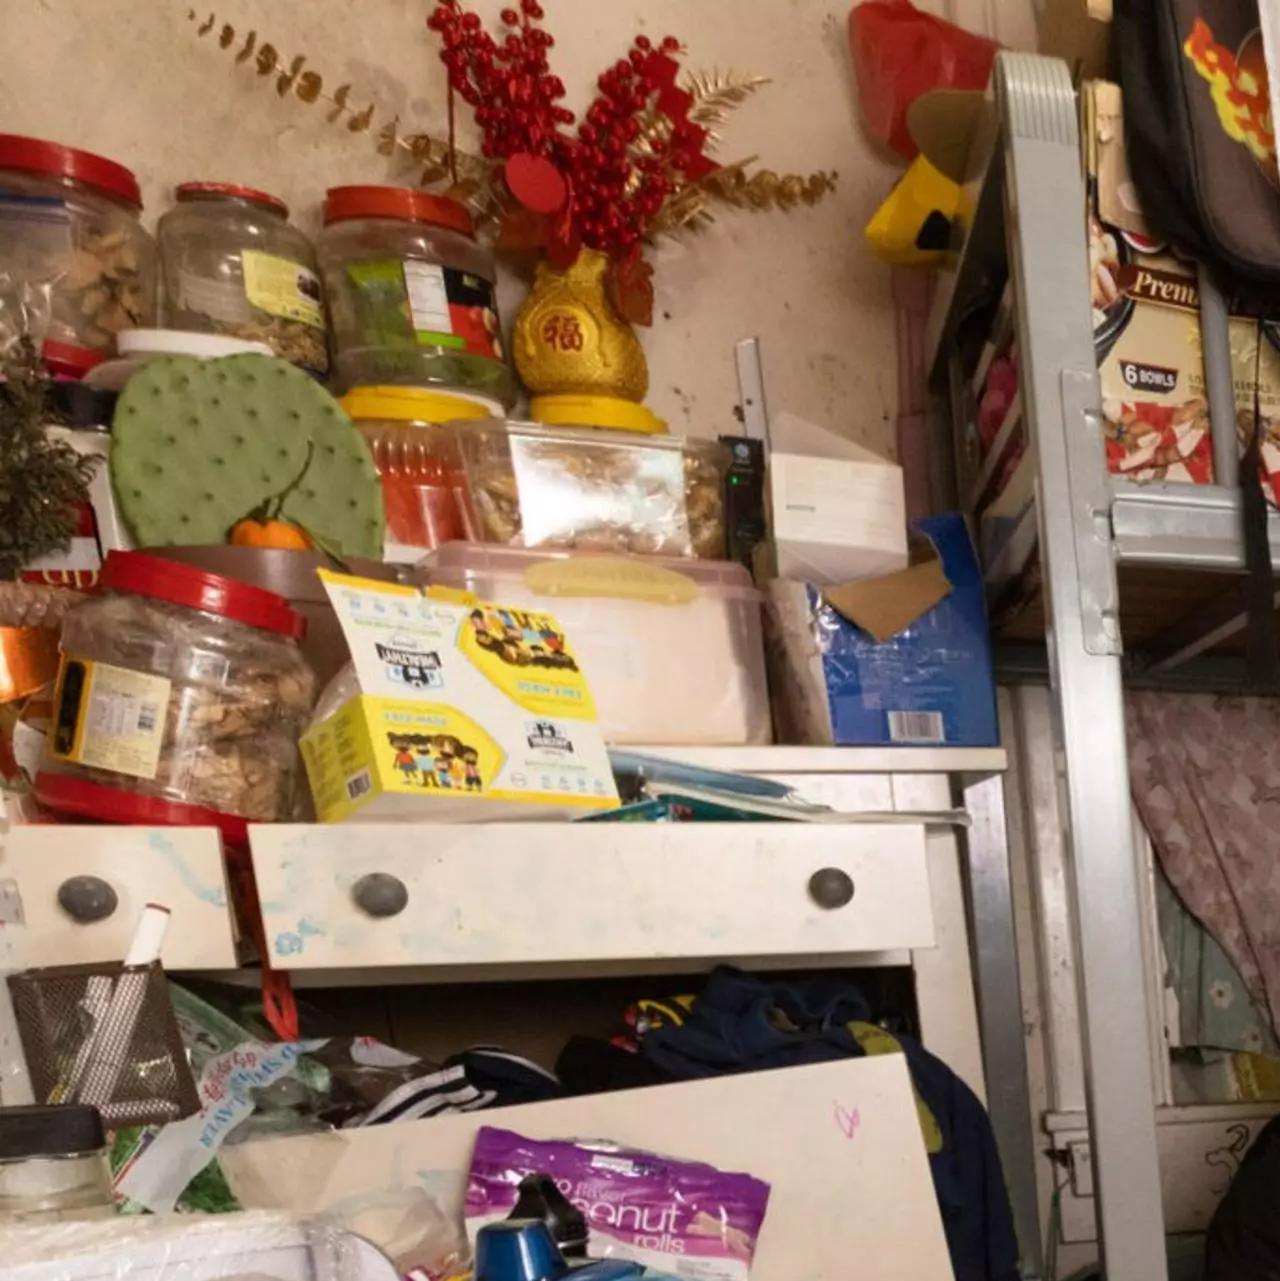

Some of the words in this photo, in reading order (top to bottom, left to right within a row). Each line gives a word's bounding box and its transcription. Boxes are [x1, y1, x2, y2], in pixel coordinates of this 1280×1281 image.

[543, 315, 584, 351] 福
[1125, 366, 1137, 385] 6
[1139, 369, 1176, 387] BOWLS
[633, 1234, 686, 1253] rolls
